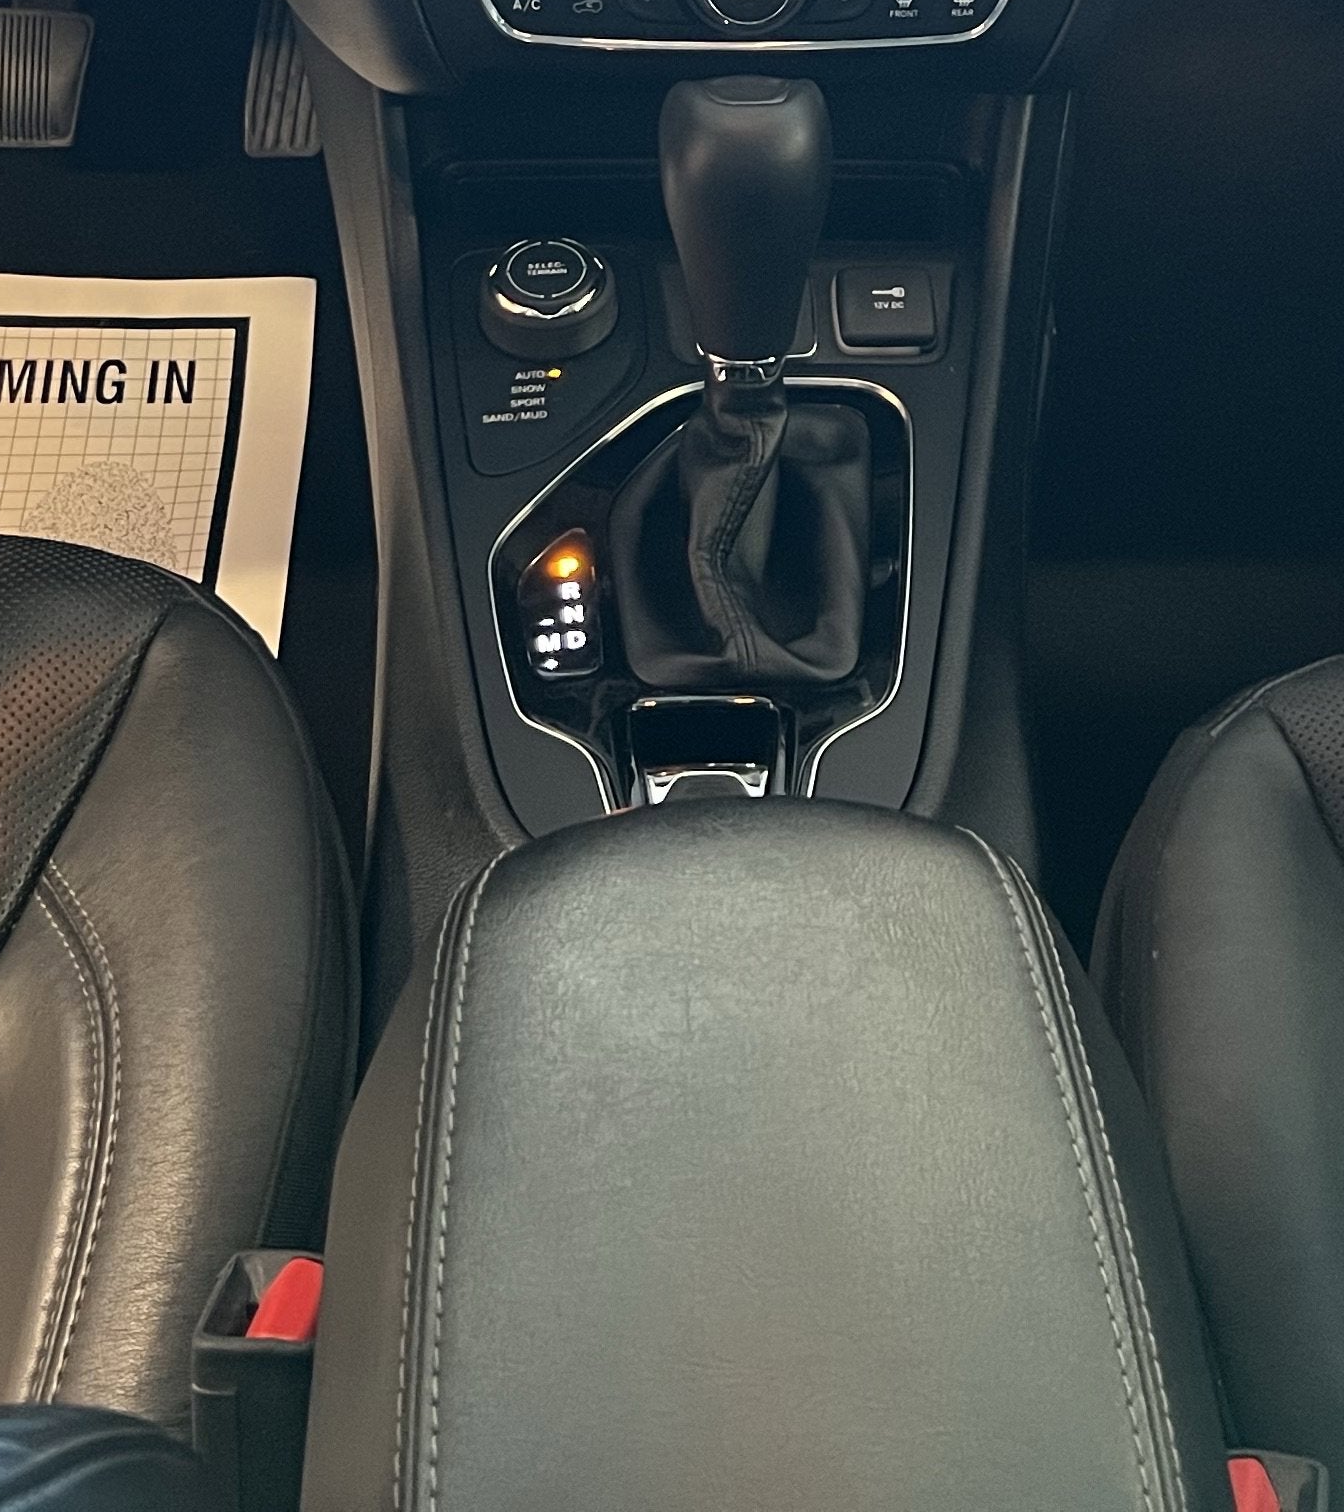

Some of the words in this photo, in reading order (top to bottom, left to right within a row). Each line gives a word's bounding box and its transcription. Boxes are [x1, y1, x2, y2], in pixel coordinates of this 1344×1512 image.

[512, 0, 542, 11] A/C
[889, 9, 919, 18] FRONT
[951, 8, 975, 17] REAR
[891, 301, 905, 309] DC
[515, 370, 545, 380] AUTO
[146, 359, 197, 405] IN
[511, 384, 546, 394] SNOW
[510, 397, 546, 408] SPORT
[482, 411, 549, 424] SAND/MUD
[560, 581, 582, 600] R
[561, 604, 585, 624] N
[536, 632, 562, 653] M
[564, 630, 587, 650] D
